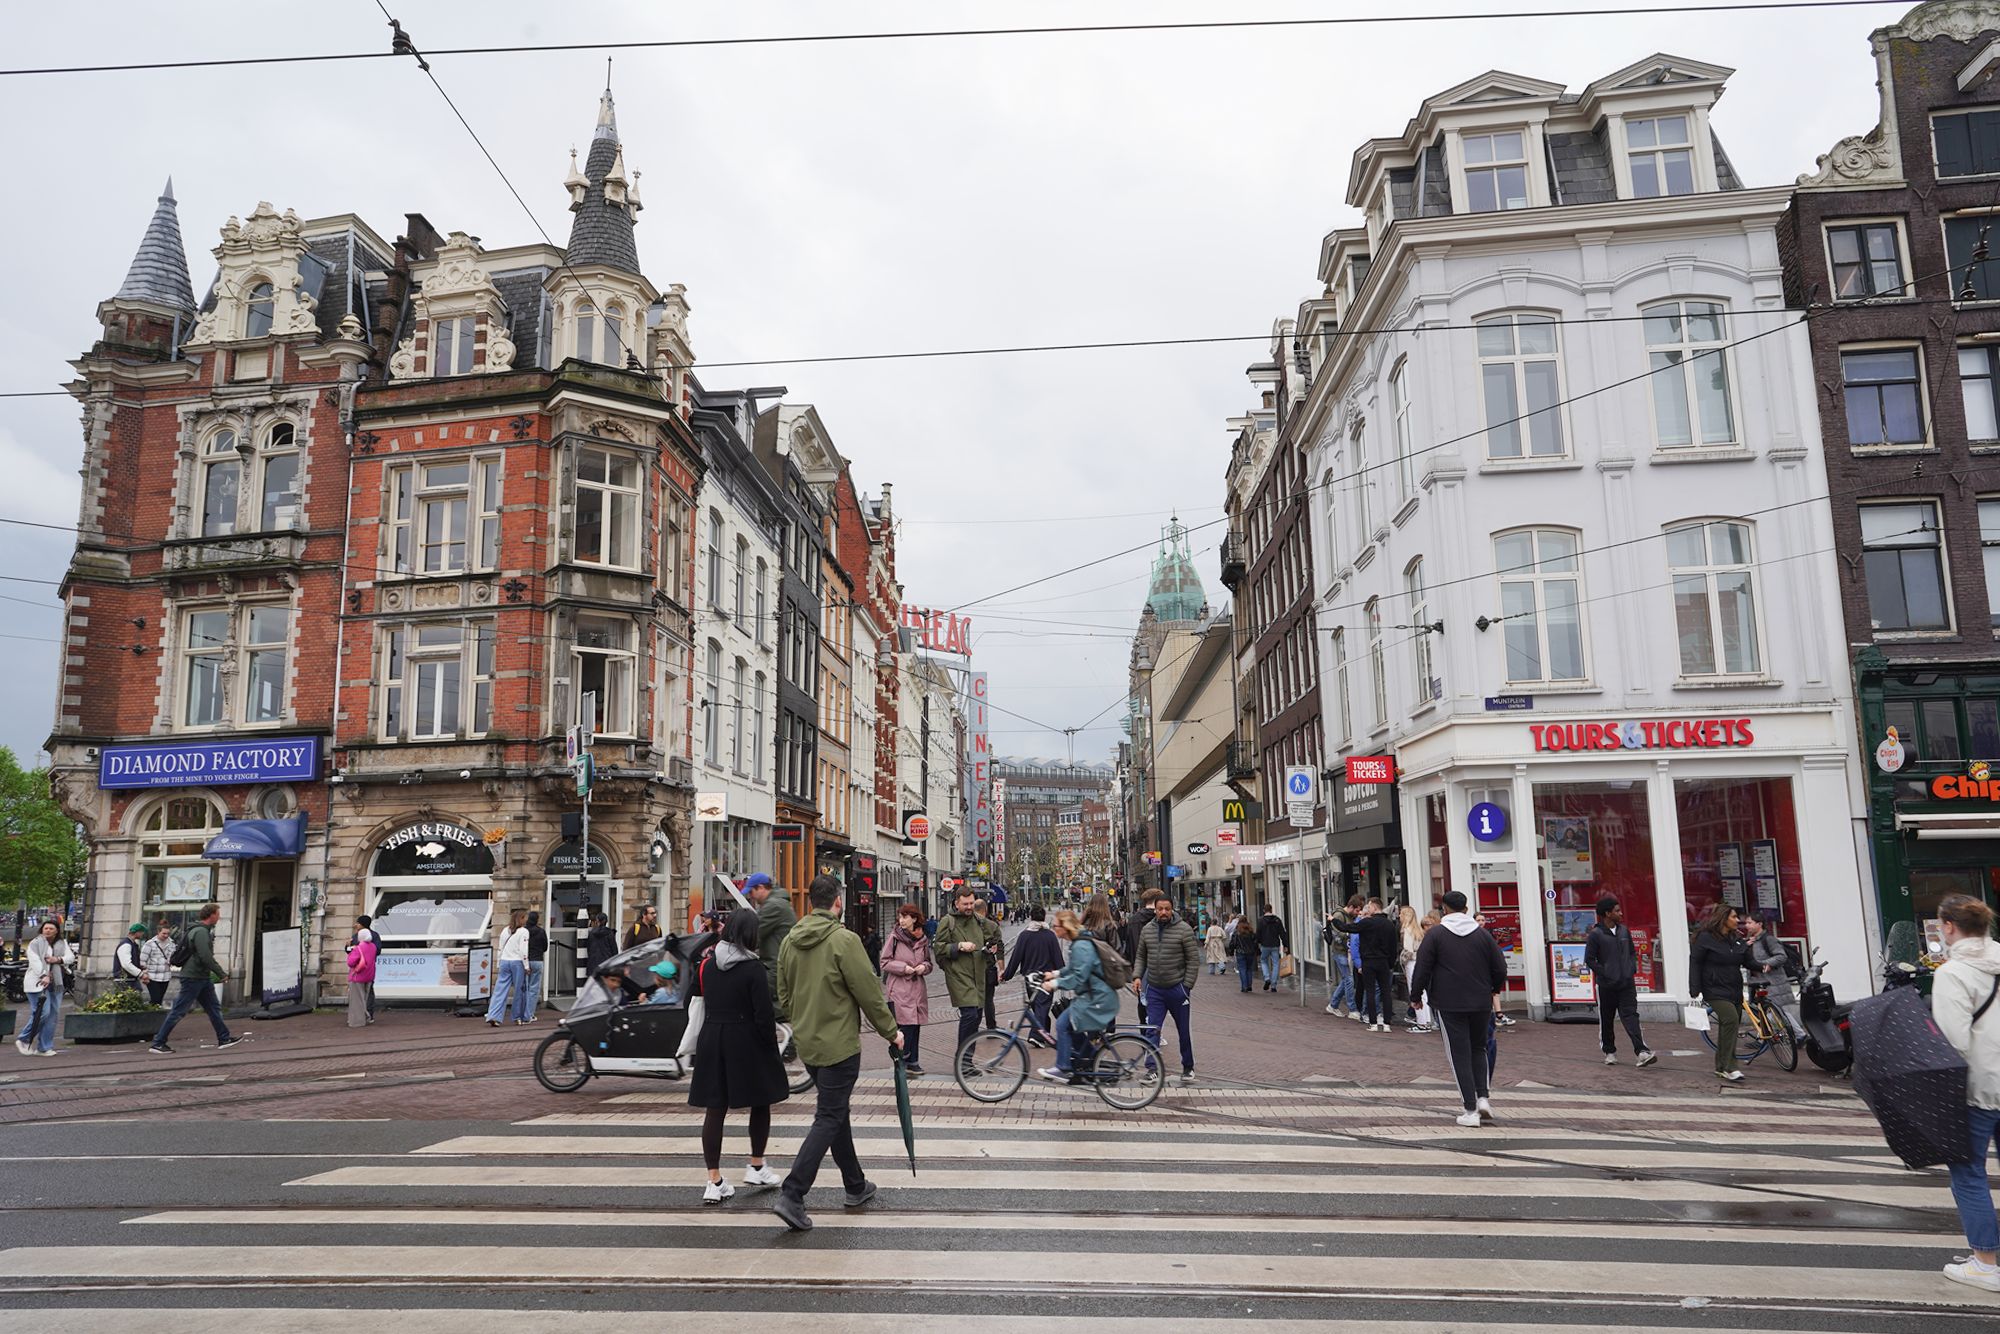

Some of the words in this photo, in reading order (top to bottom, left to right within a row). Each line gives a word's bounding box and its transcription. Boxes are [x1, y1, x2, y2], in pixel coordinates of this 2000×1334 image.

[110, 752, 206, 775] DIAMOND
[211, 747, 306, 771] FACTORY
[975, 678, 987, 839] CINEAC
[1887, 759, 1899, 768] King
[150, 776, 170, 784] FROM
[171, 775, 184, 783] THE
[185, 774, 204, 782] MINE
[214, 773, 233, 781] YOUR
[234, 771, 259, 780] FINGER
[1353, 770, 1387, 779] TICKETS
[996, 784, 1004, 862] PIZZERIA
[389, 825, 420, 850] FISH
[421, 824, 433, 836] &
[435, 823, 474, 848] FRIES
[1900, 886, 1908, 896] 5
[377, 957, 404, 965] FRESH
[407, 957, 426, 965] COD
